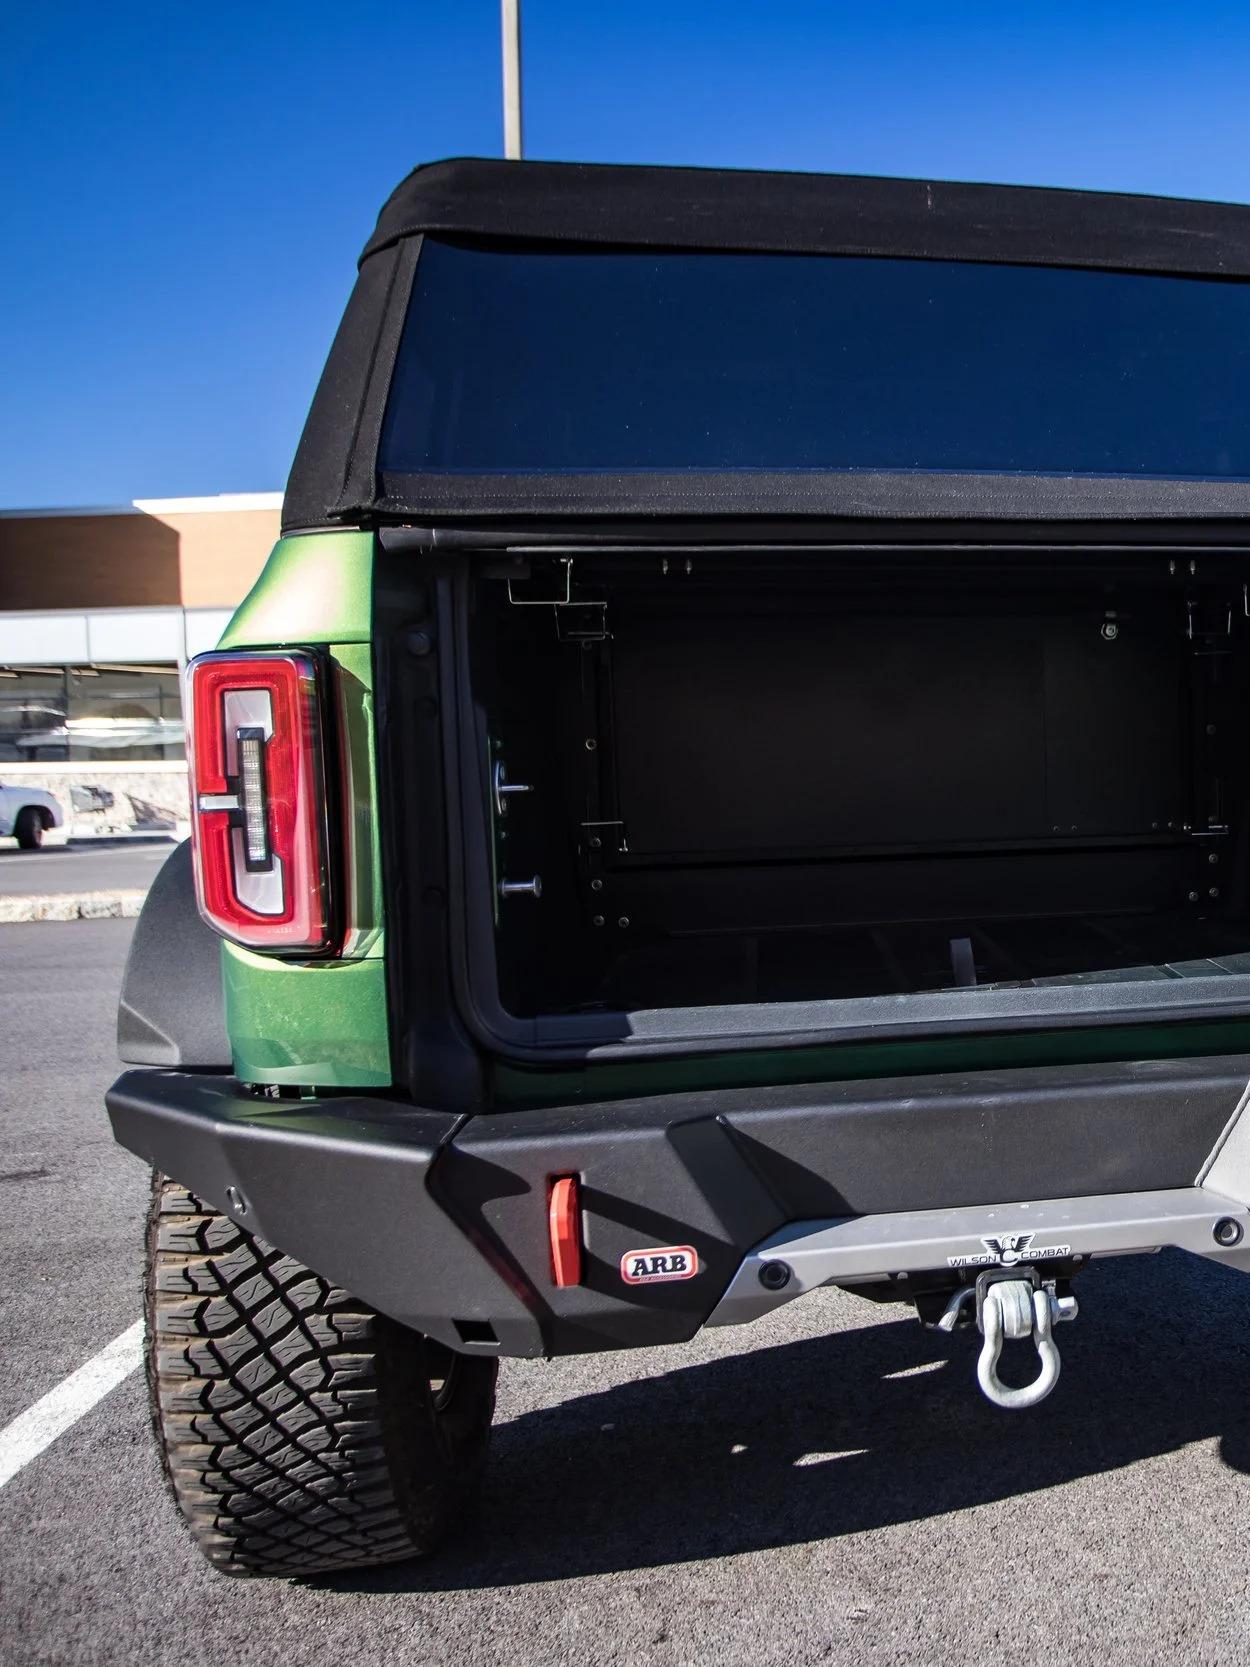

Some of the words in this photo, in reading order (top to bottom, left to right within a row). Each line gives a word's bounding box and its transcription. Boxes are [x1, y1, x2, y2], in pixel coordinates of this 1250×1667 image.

[631, 1254, 687, 1277] ARB
[950, 1254, 997, 1267] WILSON
[1020, 1247, 1069, 1260] COMBAT
